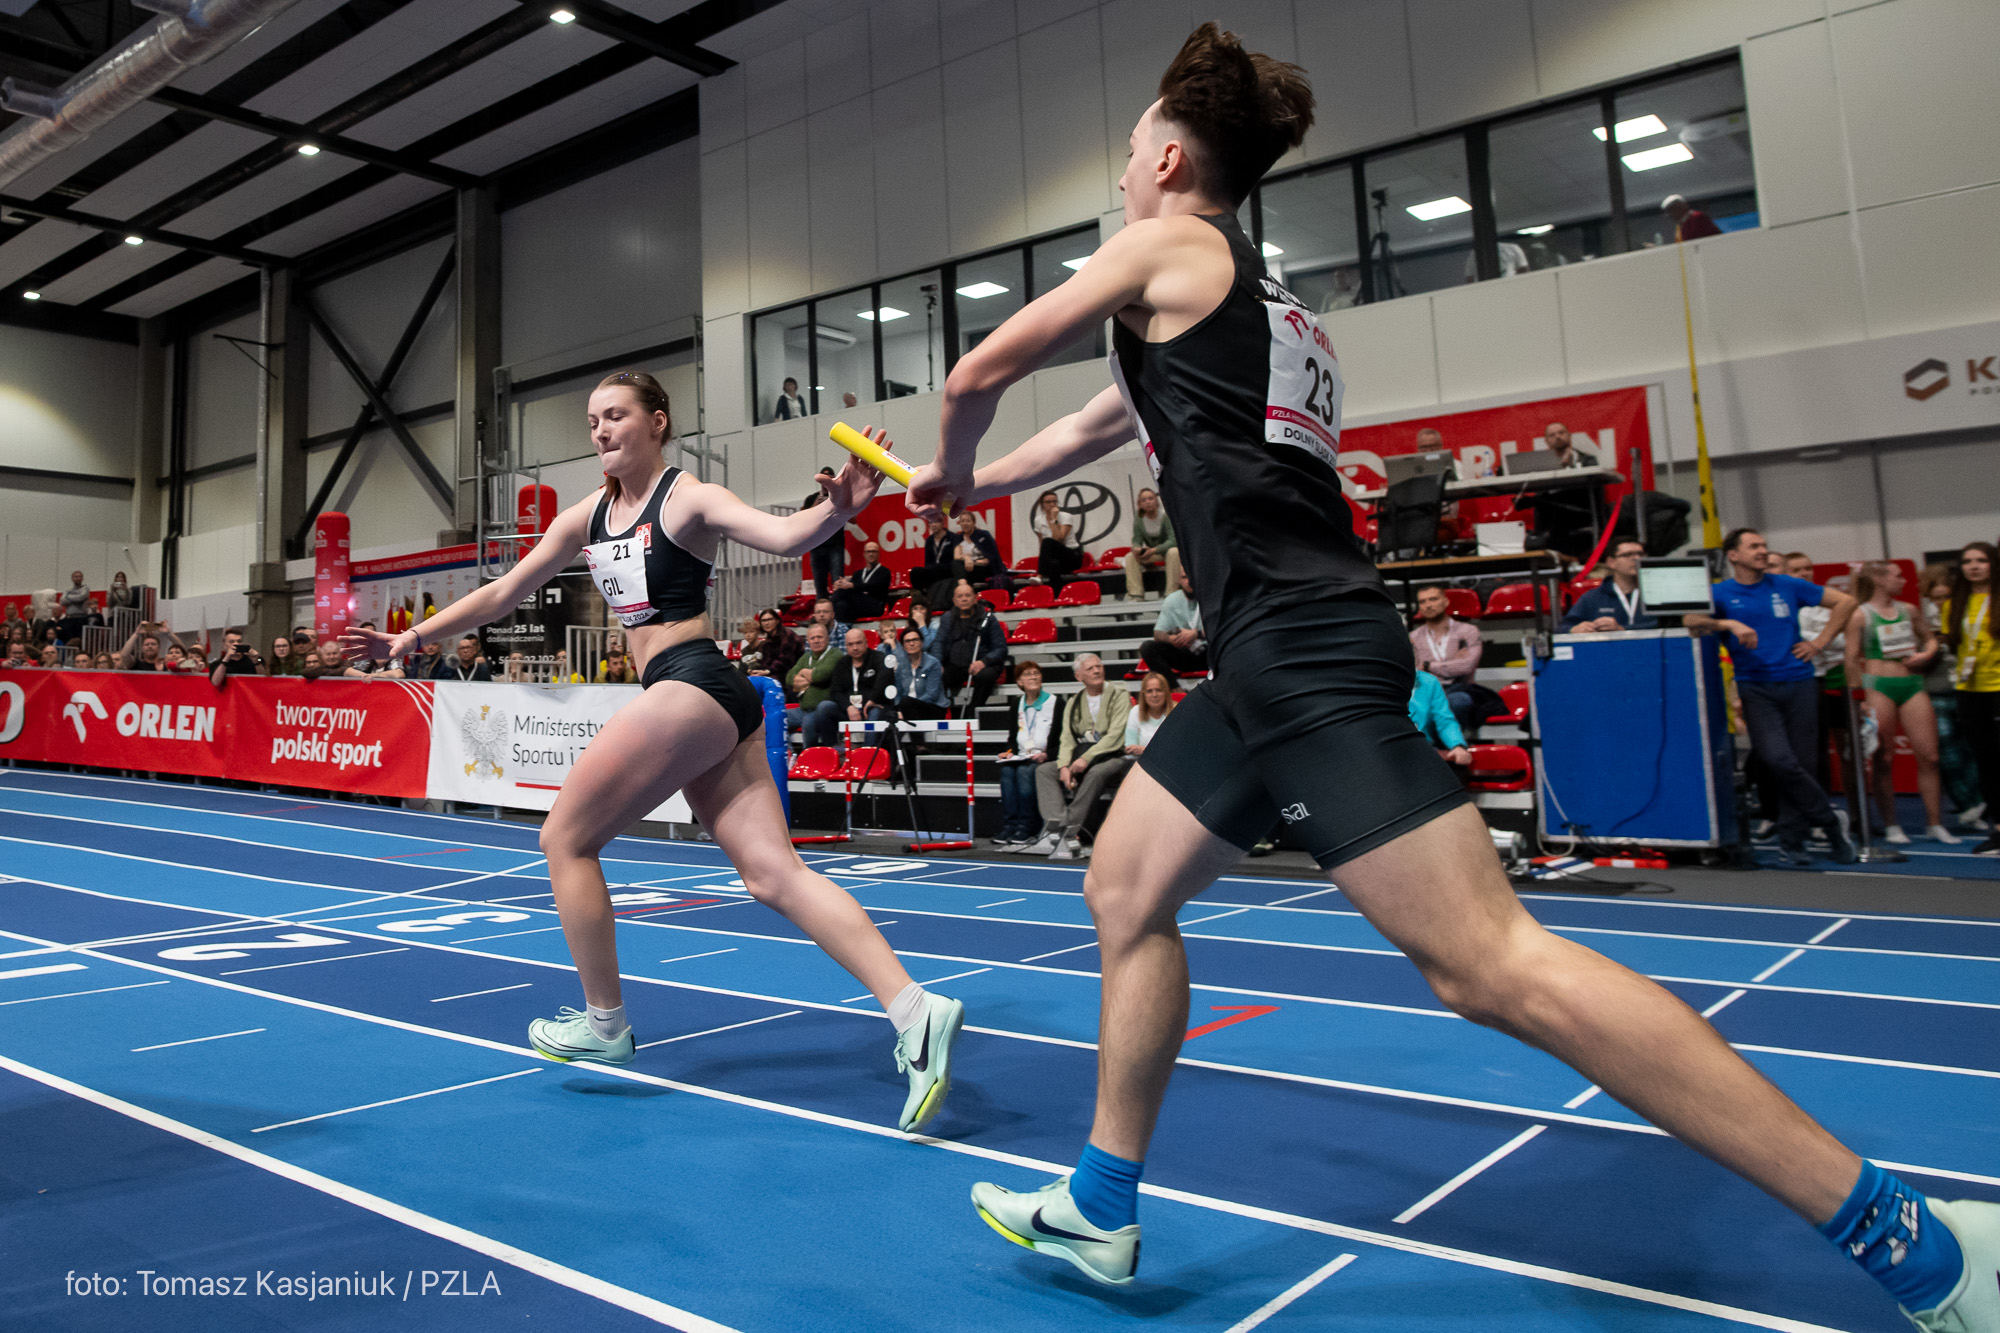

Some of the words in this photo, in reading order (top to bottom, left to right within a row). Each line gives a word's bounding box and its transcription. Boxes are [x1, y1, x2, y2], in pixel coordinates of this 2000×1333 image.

[1304, 356, 1334, 427] 23
[1271, 409, 1291, 419] PZLA
[1283, 426, 1316, 448] DOLNY
[613, 543, 631, 561] 21
[603, 577, 624, 596] GIL
[486, 634, 545, 643] doświadczenia
[514, 624, 528, 634] 25
[529, 623, 546, 633] lat
[116, 701, 217, 742] ORLEN
[276, 699, 367, 737] tworzymy
[271, 731, 330, 764] polski
[331, 740, 383, 770] sport
[512, 743, 564, 767] Sportu
[569, 746, 575, 766] i
[376, 911, 531, 933] 3
[157, 932, 351, 961] 2
